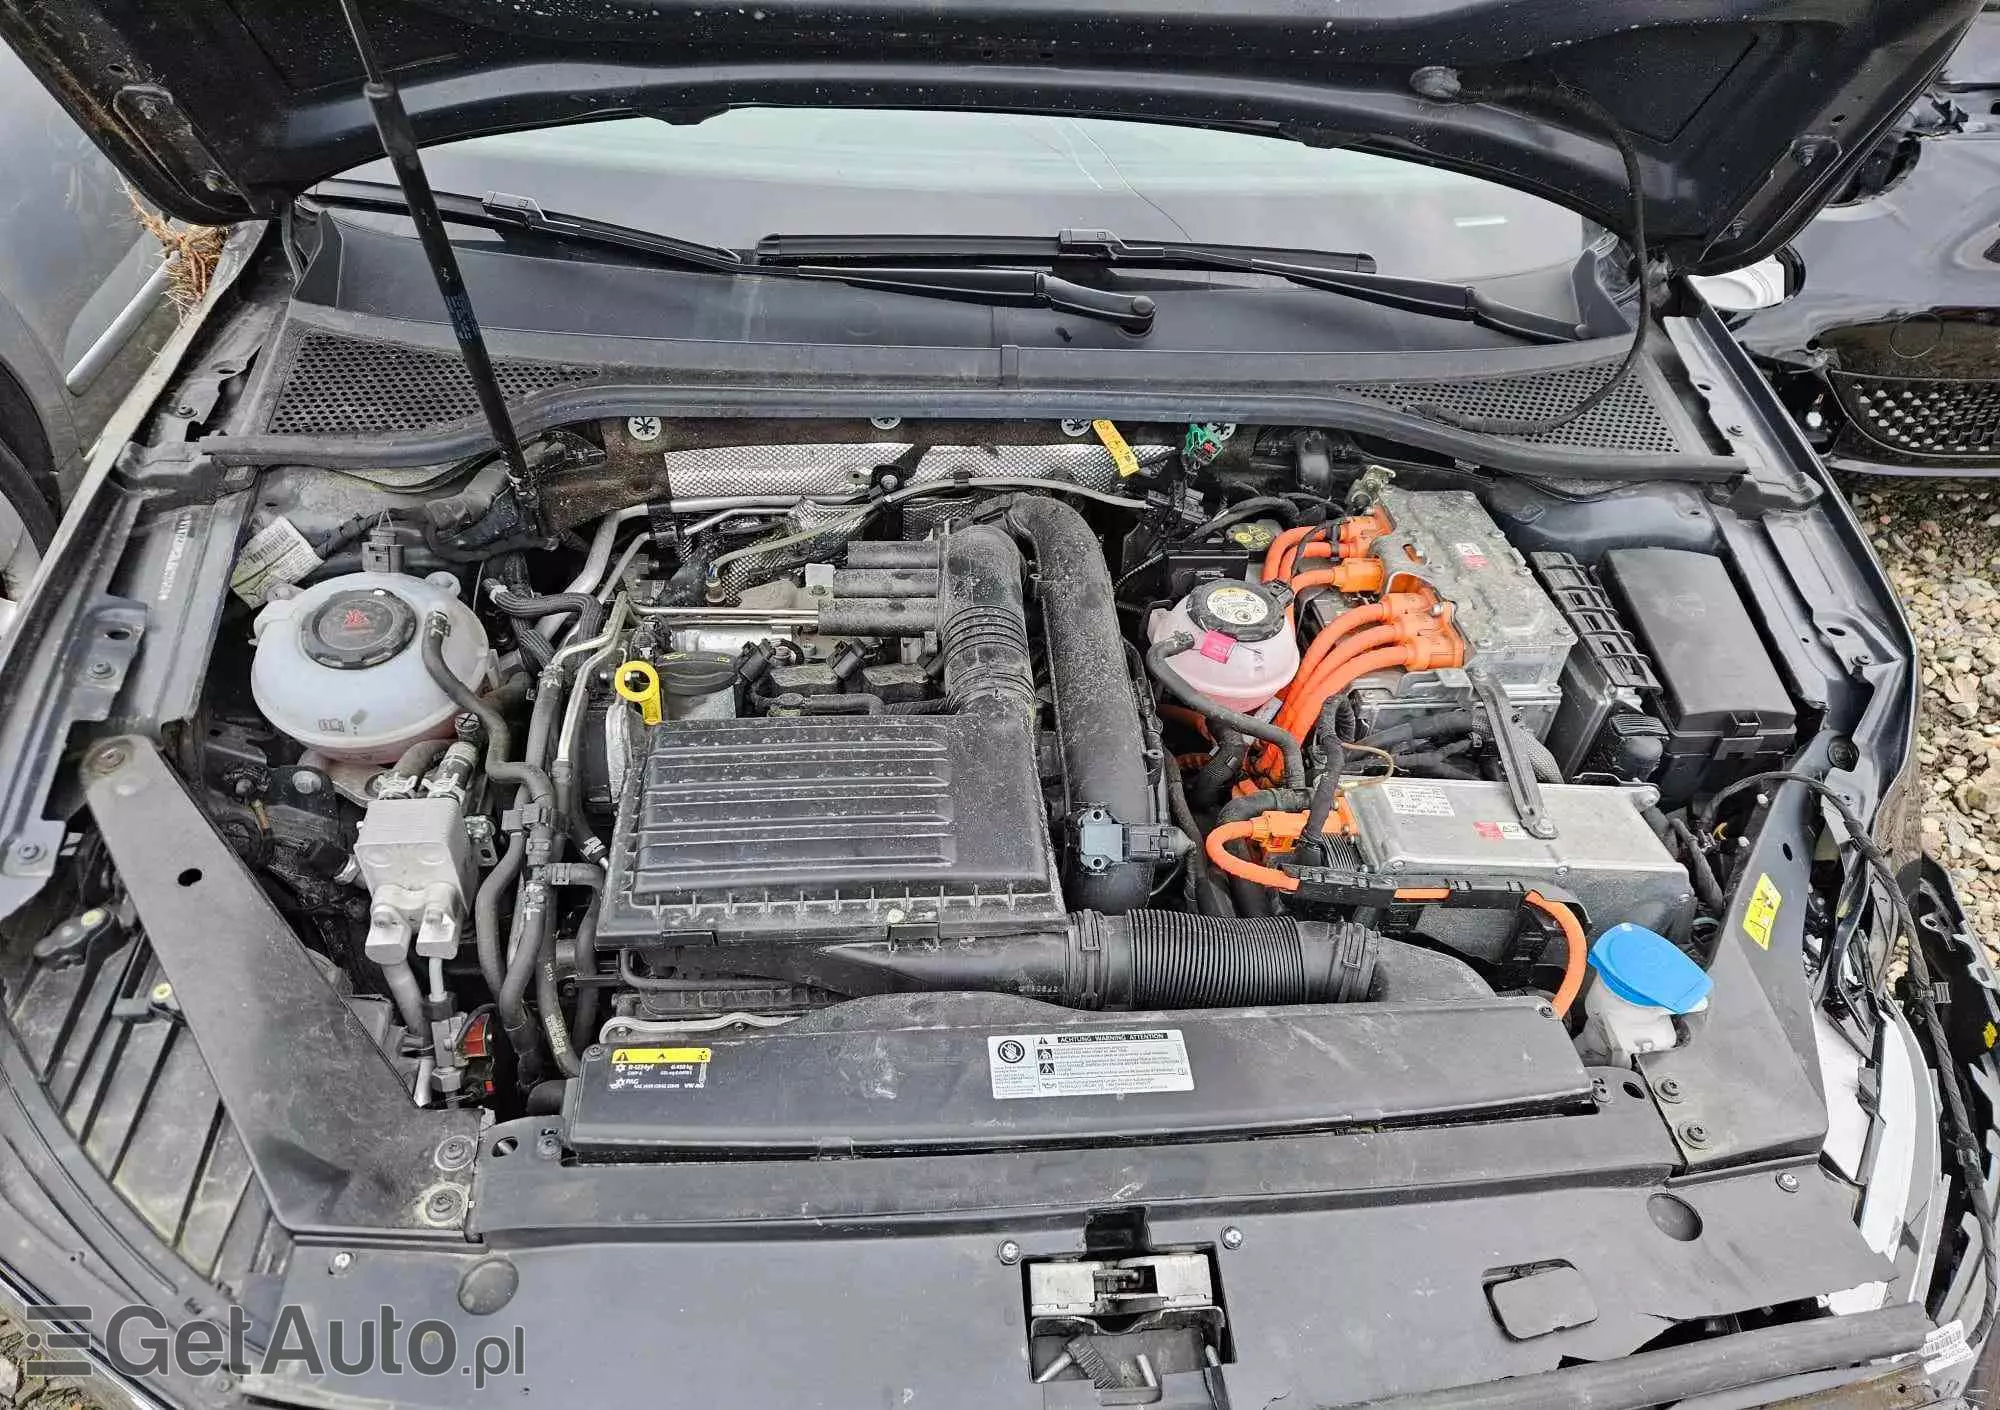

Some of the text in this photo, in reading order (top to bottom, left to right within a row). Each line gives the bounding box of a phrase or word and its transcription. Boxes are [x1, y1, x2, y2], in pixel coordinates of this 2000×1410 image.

[1059, 1032, 1165, 1044] ACHTUNG WARNING ATTENTION
